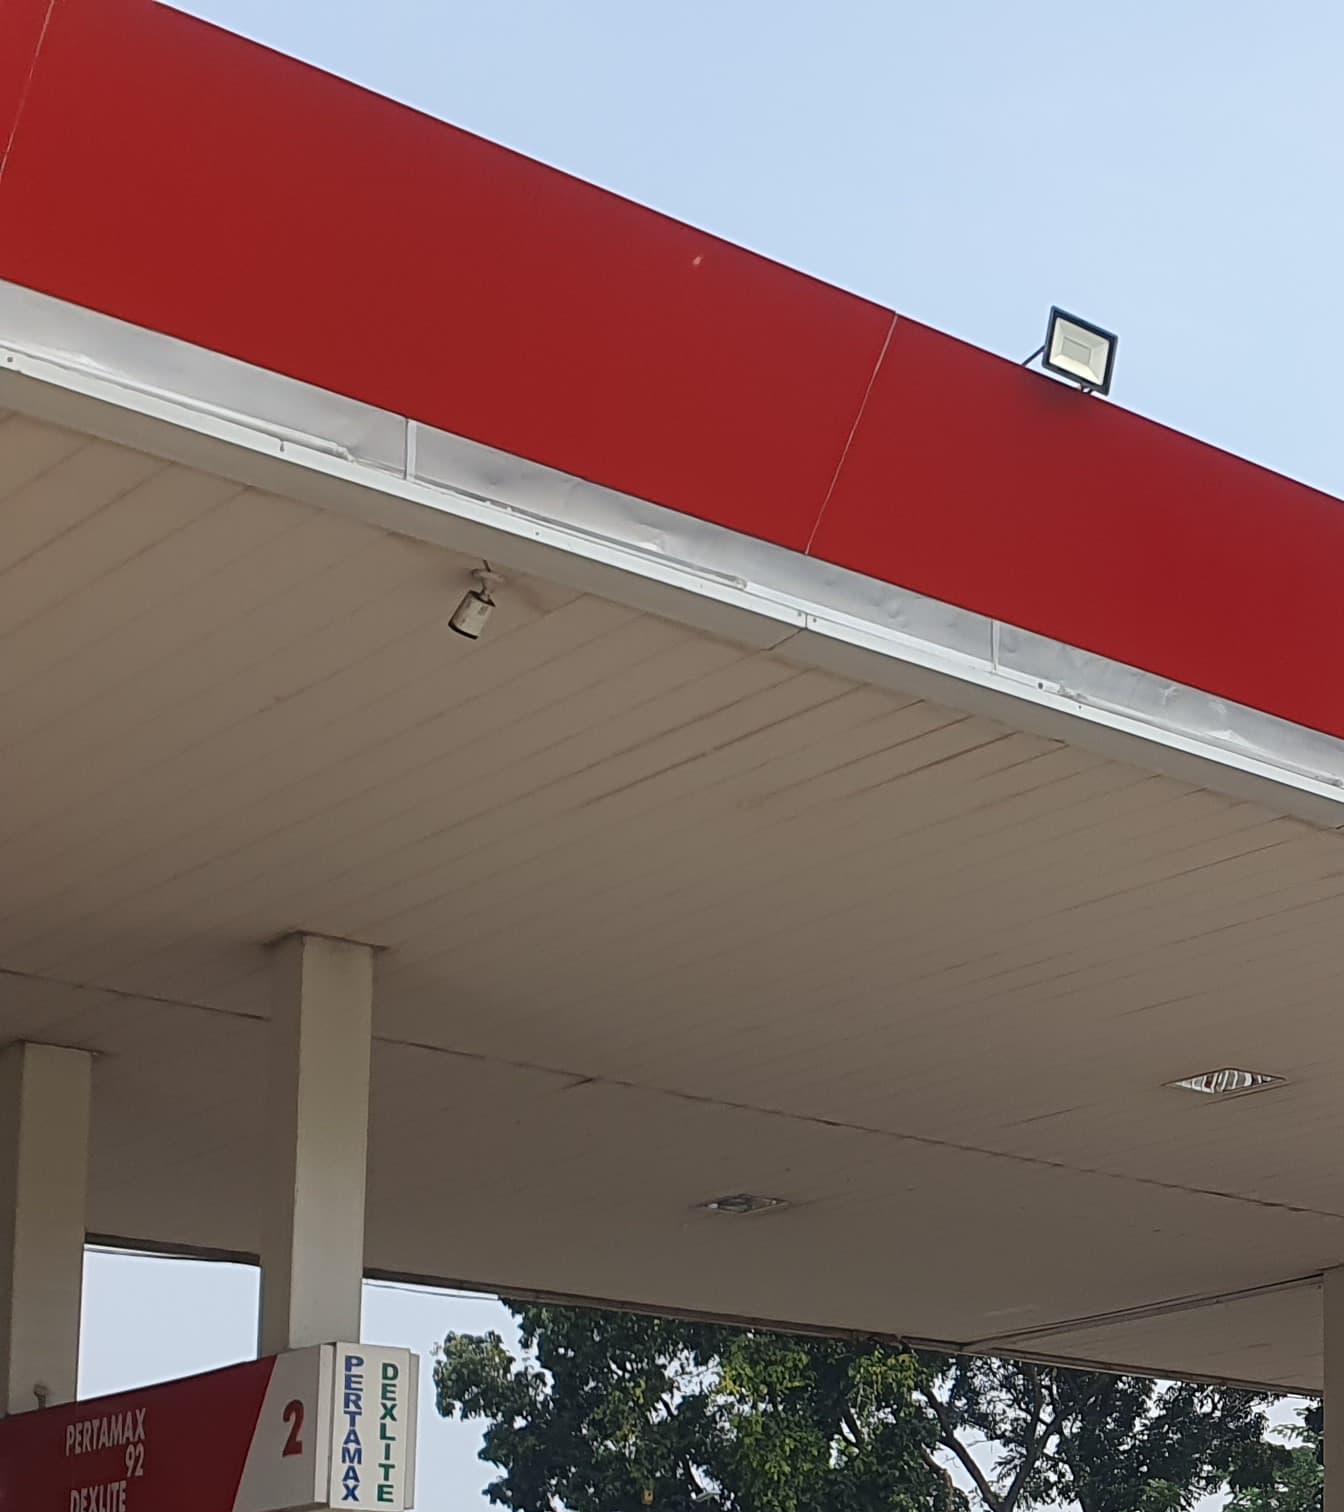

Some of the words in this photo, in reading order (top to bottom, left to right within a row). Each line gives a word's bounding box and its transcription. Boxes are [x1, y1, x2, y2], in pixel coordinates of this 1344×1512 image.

[66, 1408, 146, 1456] PERTAMAX
[282, 1400, 304, 1457] 2
[342, 1355, 364, 1501] PERTAMAX
[377, 1363, 399, 1502] DEXLITE
[125, 1444, 143, 1478] 92
